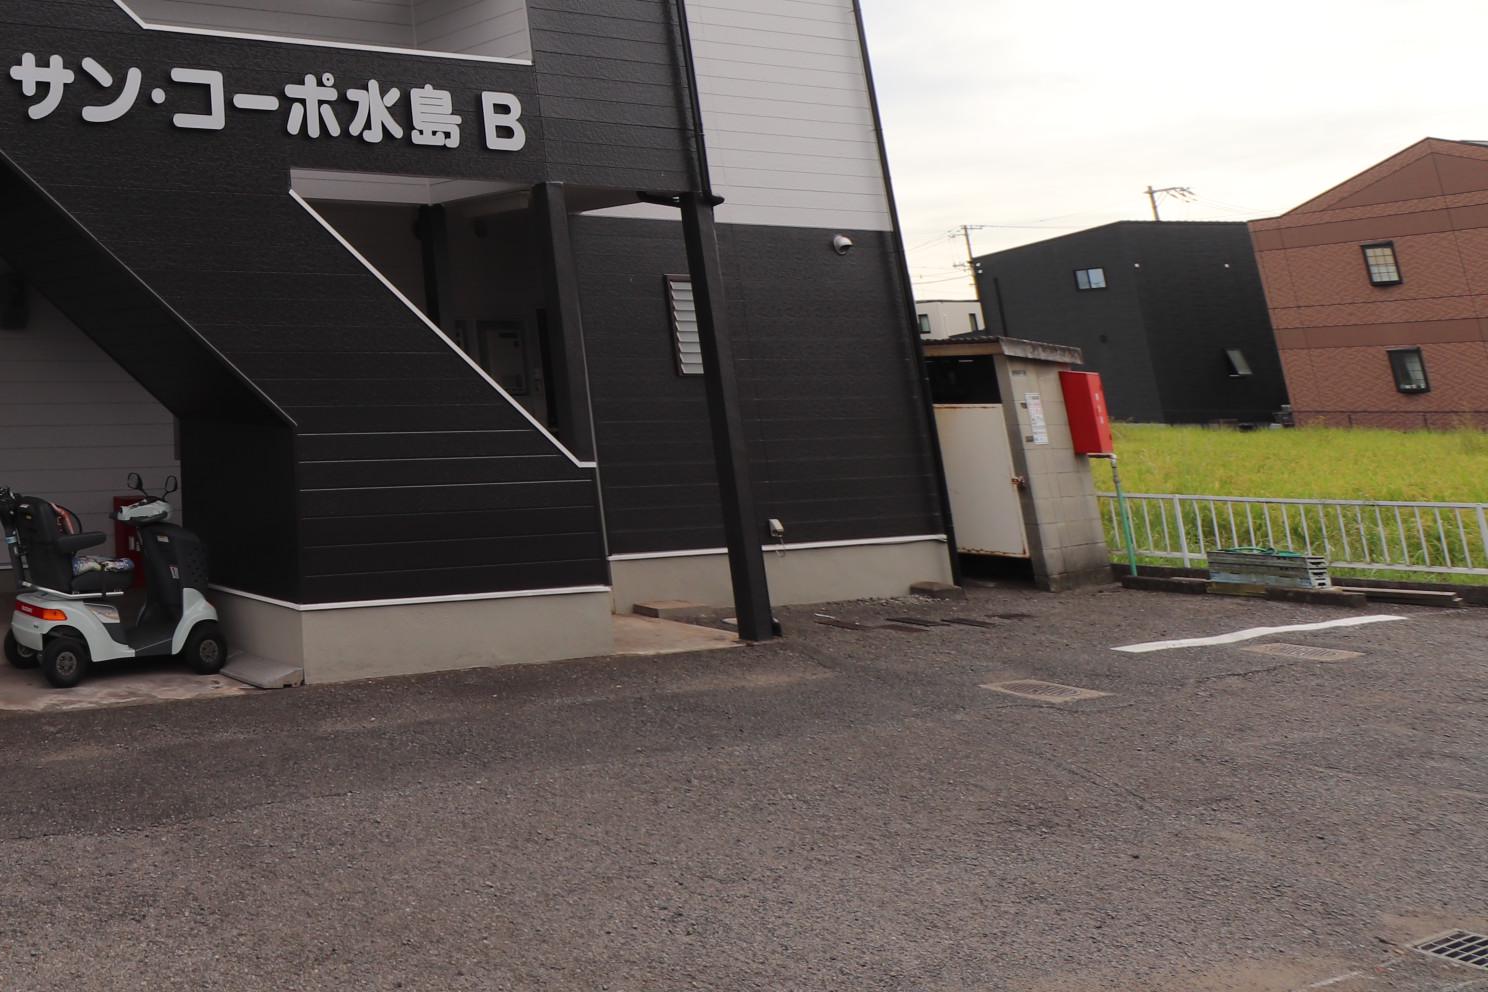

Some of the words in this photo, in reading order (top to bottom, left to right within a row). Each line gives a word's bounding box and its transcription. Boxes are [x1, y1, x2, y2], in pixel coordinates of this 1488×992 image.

[9, 52, 462, 149] サン・コーポ水島
[481, 90, 527, 151] B
